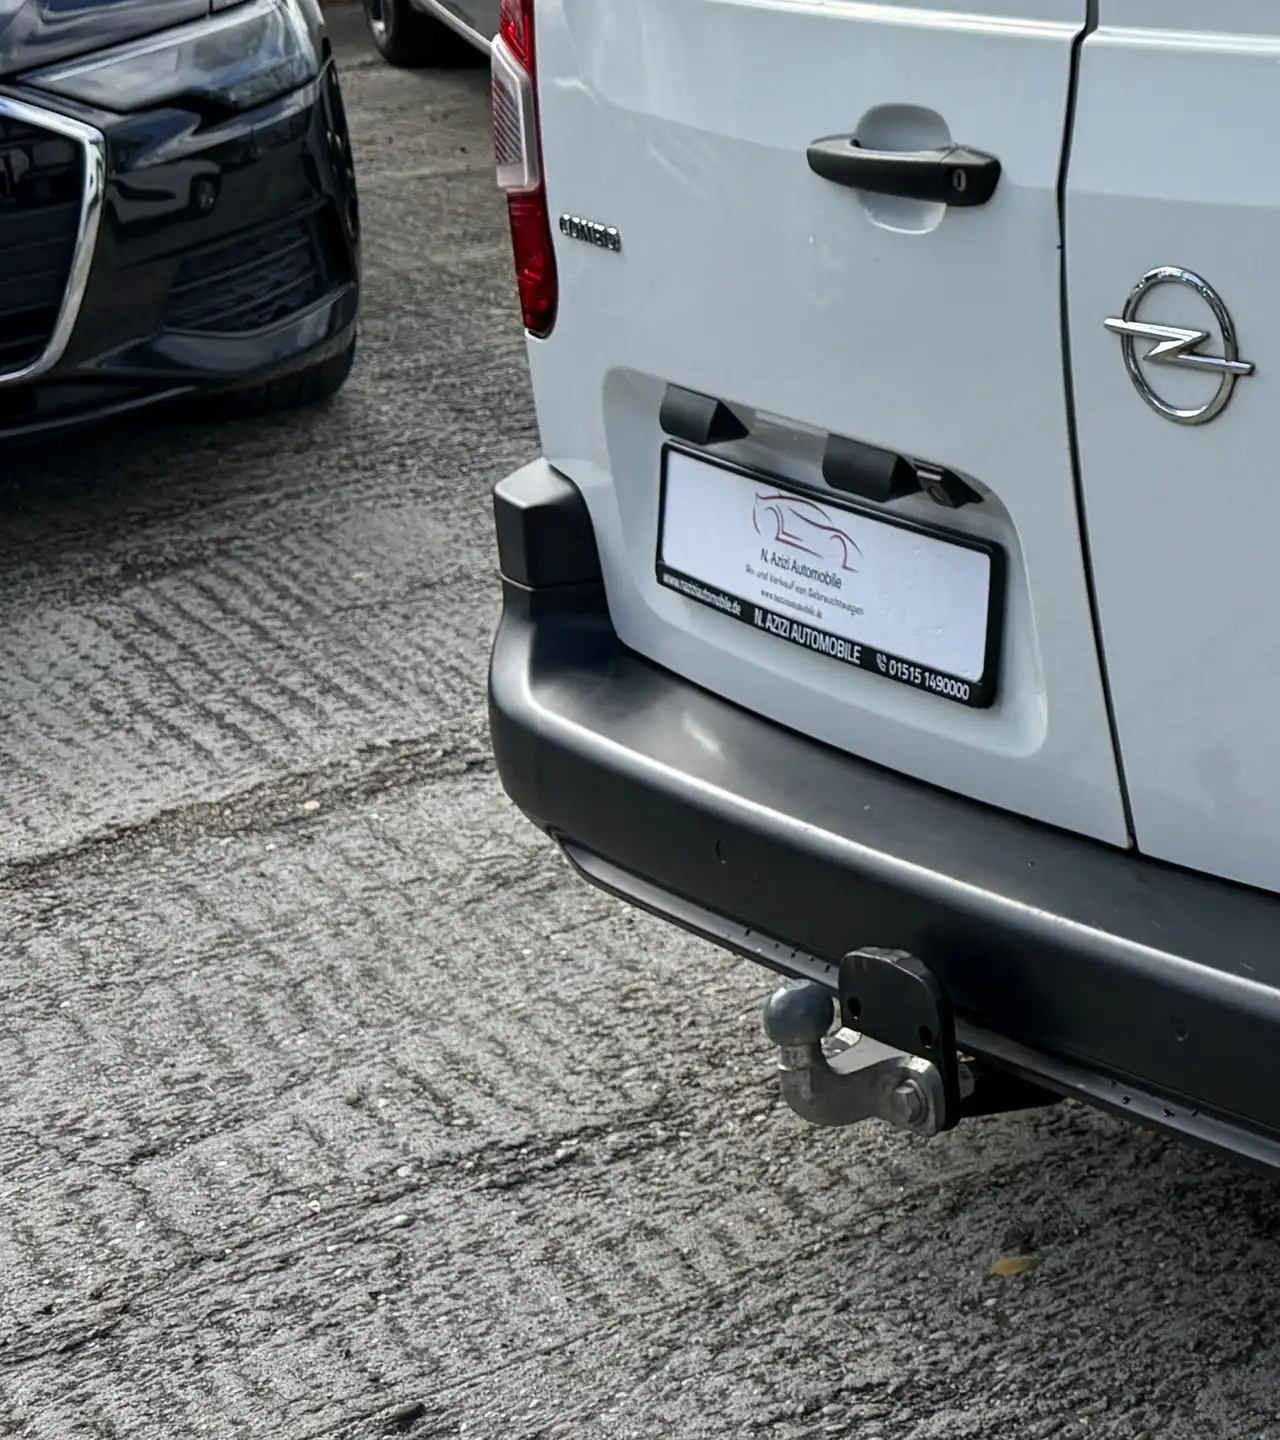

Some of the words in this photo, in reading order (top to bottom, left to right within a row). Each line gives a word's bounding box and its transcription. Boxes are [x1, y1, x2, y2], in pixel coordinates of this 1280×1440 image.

[760, 548, 769, 563] N.
[770, 552, 790, 570] Azizi
[791, 560, 842, 589] Automobile
[754, 607, 764, 627] N.
[765, 613, 790, 638] AZIZI
[791, 624, 862, 664] AUTOMOBILE
[889, 660, 922, 684] 01515
[924, 672, 970, 701] 1490000
